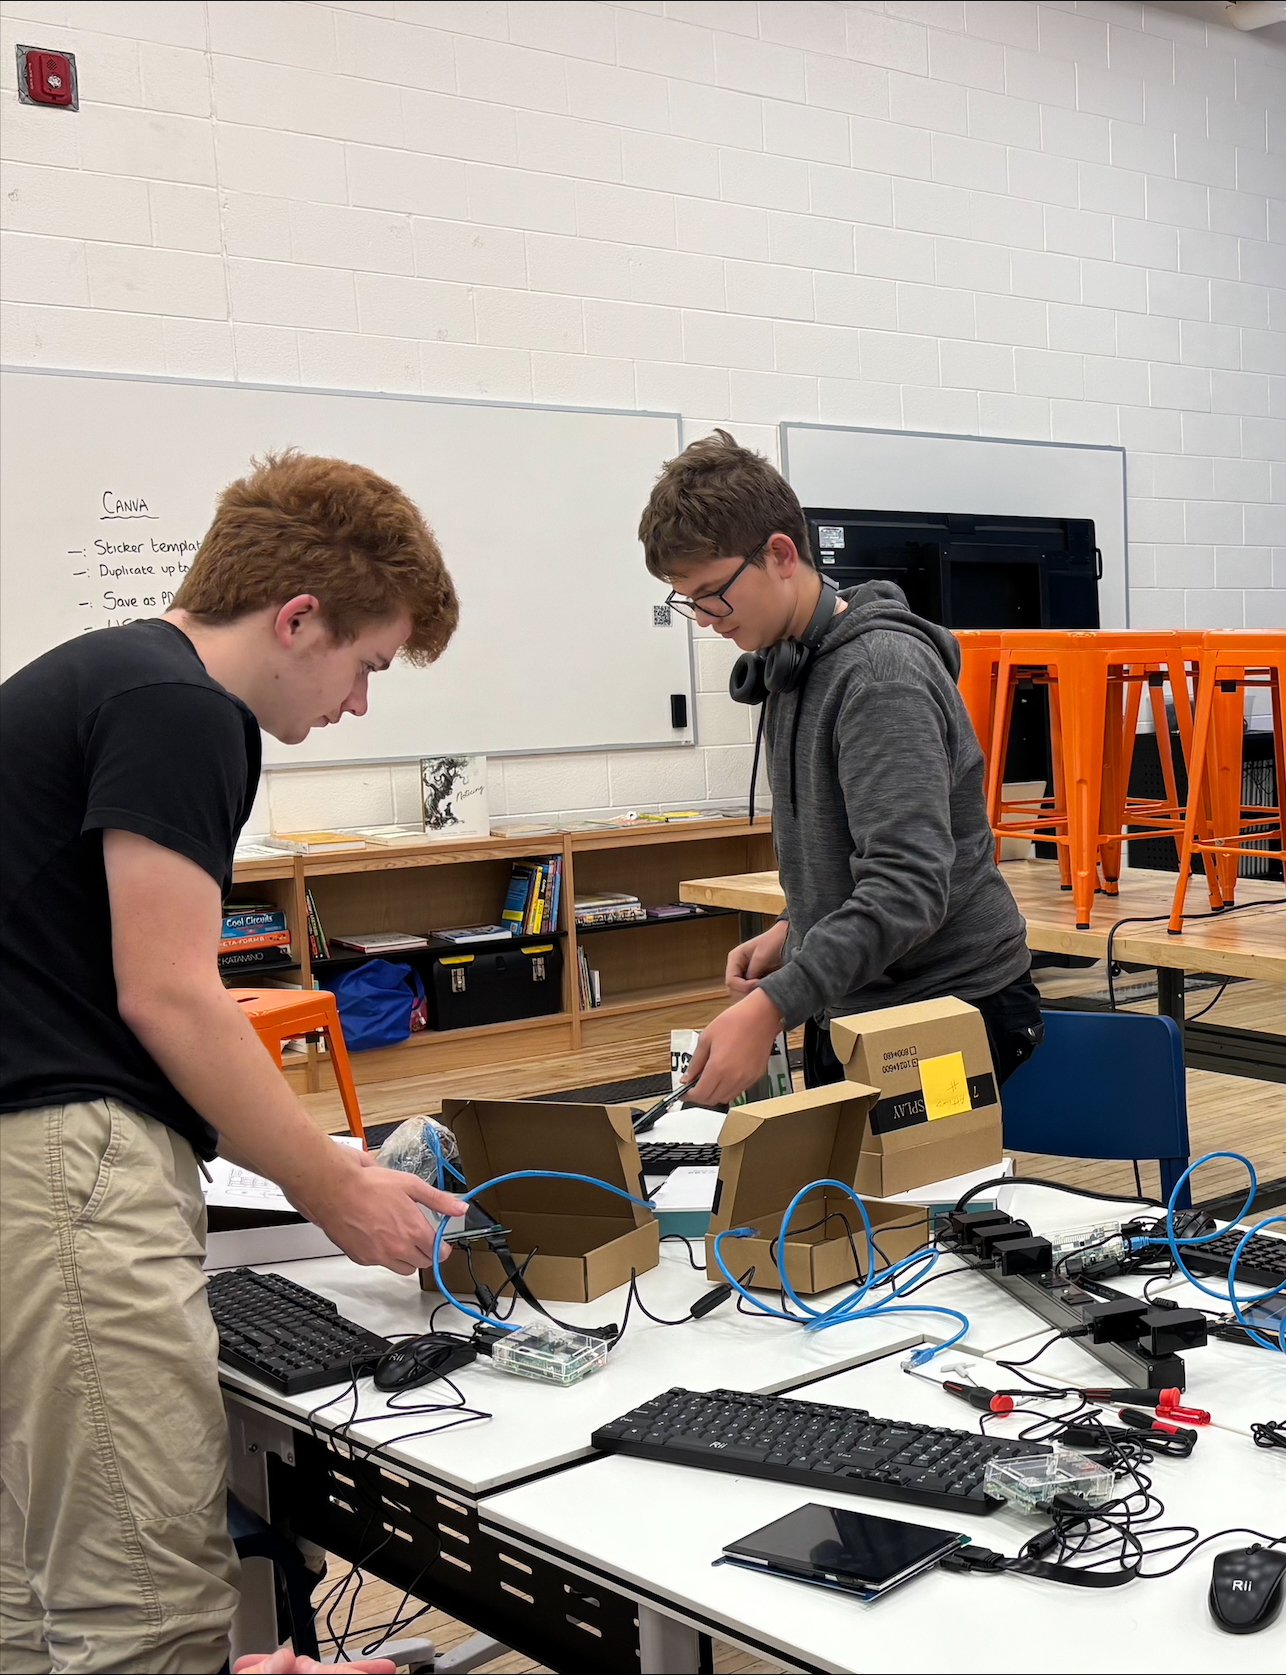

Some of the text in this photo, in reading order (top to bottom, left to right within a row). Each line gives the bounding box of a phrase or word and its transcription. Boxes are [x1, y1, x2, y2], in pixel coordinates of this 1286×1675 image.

[94, 539, 144, 556] Sticker
[100, 564, 155, 579] Duplicate
[161, 566, 175, 577] up
[103, 591, 138, 610] Save
[143, 597, 156, 607] as
[456, 786, 485, 802] Noticing
[226, 917, 244, 928] Cool
[246, 914, 273, 925] Circuits
[222, 952, 264, 965] KATAMINO
